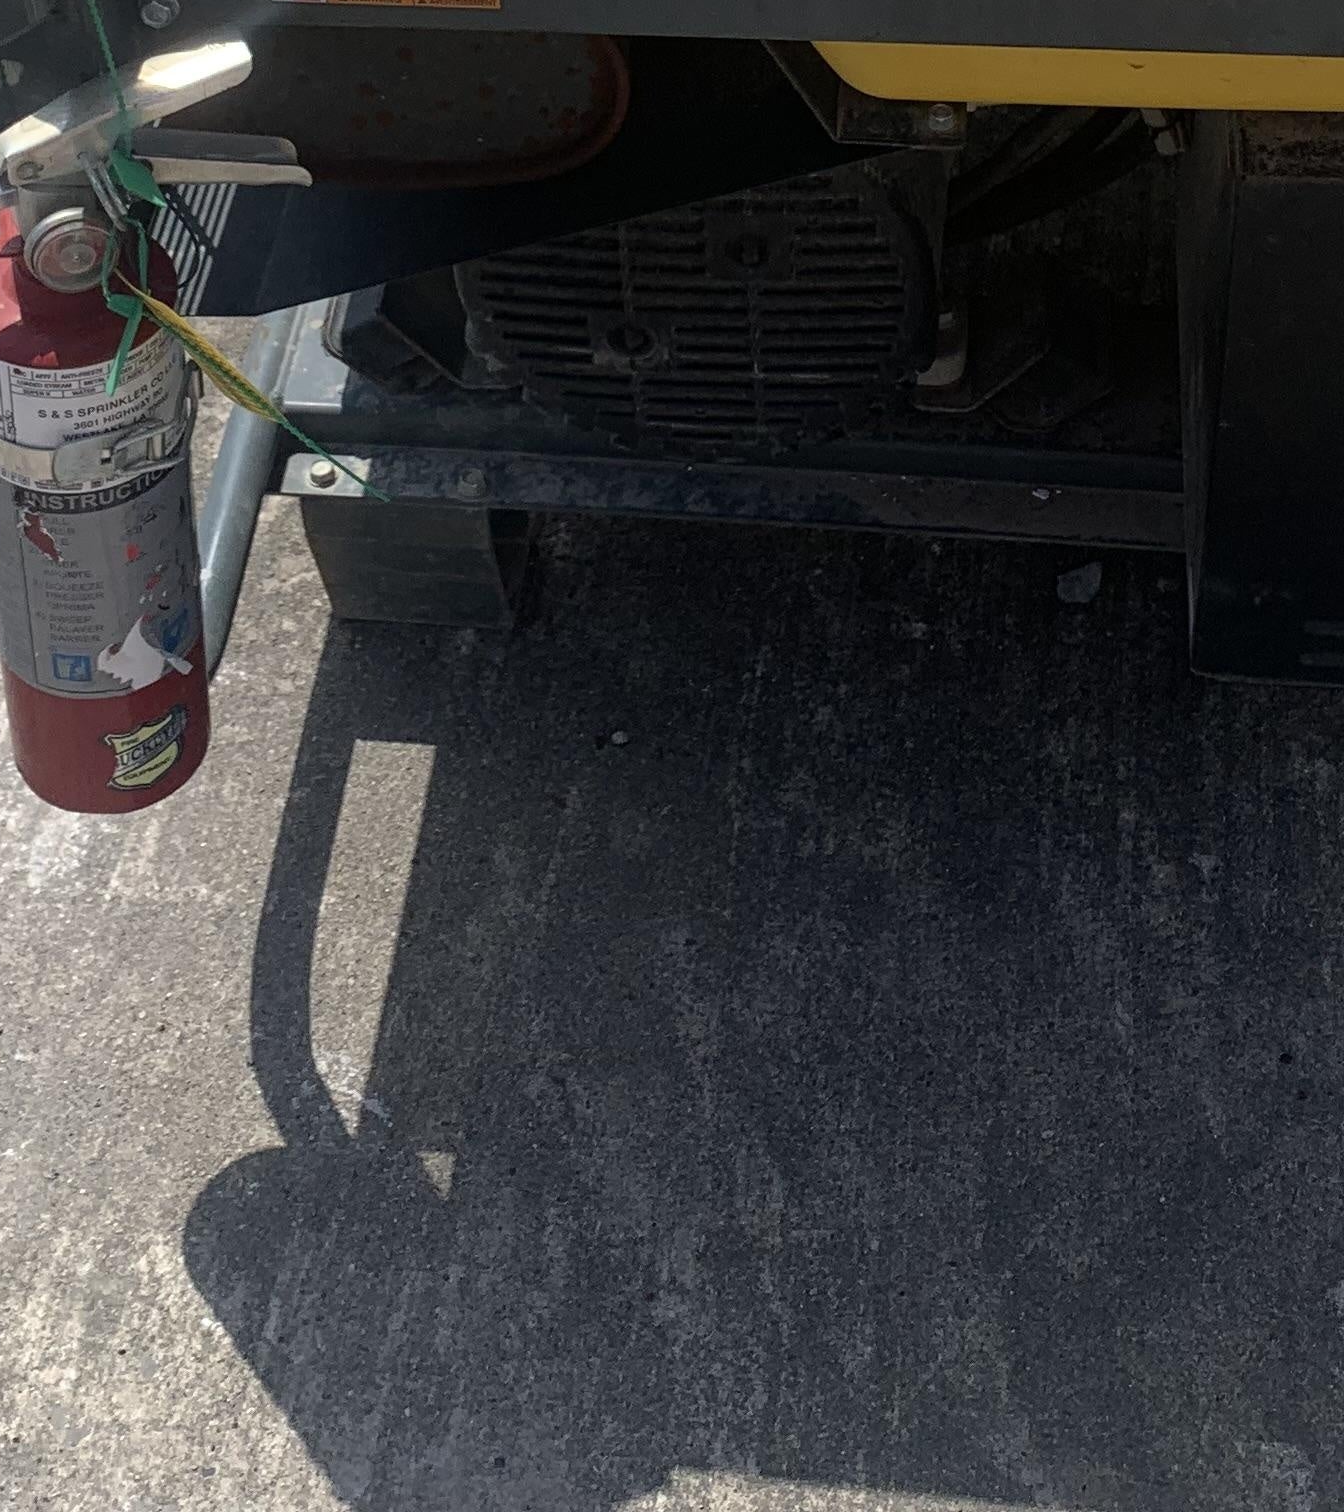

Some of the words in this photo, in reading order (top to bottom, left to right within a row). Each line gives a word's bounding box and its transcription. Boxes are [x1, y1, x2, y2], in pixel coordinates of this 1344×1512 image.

[38, 409, 47, 418] S
[51, 410, 60, 418] &
[64, 409, 74, 418] S
[78, 384, 148, 417] SPRINKLER
[151, 371, 163, 388] CO
[103, 395, 151, 425] HIGHWAY
